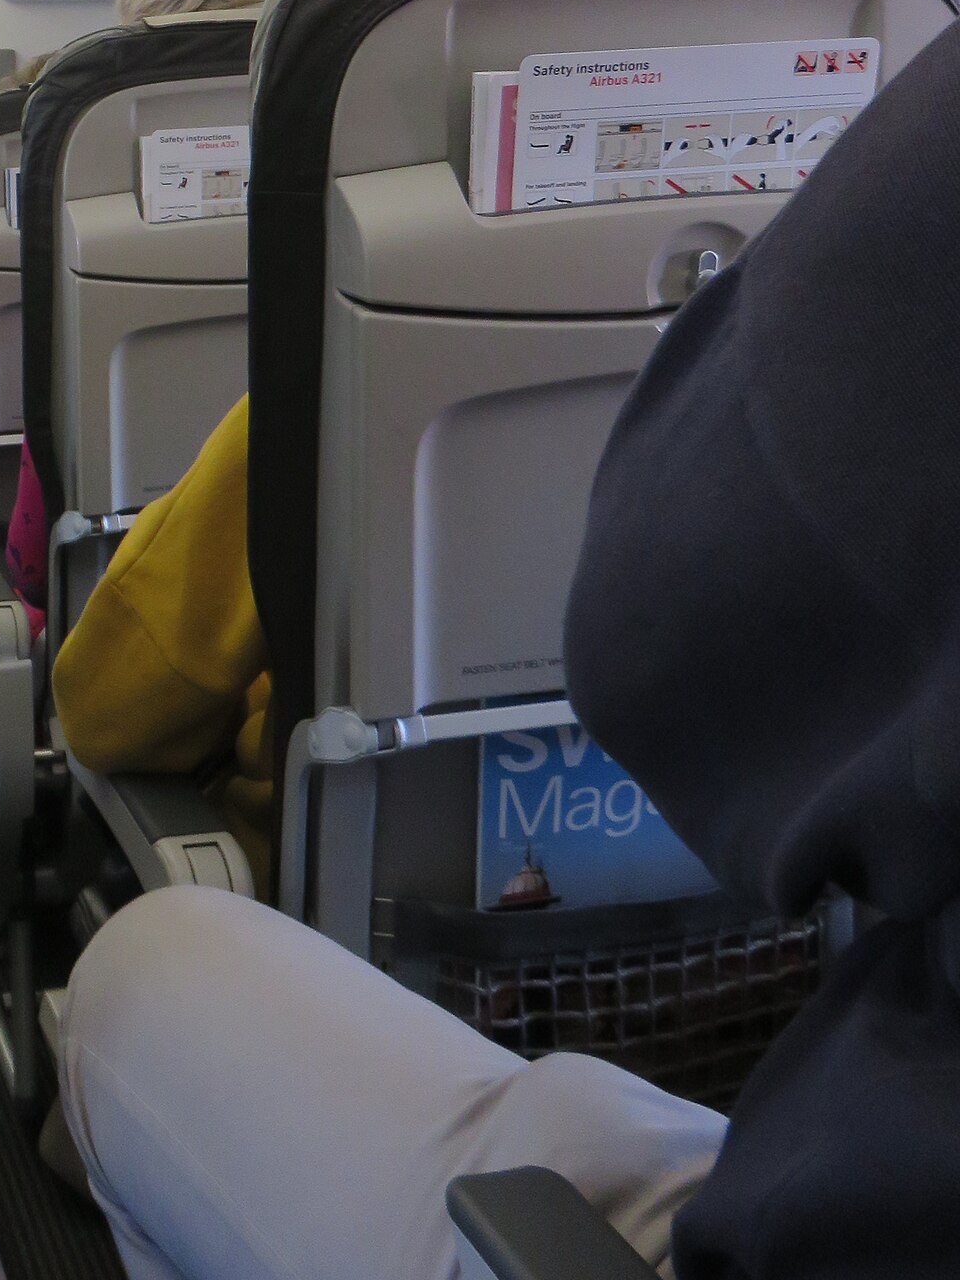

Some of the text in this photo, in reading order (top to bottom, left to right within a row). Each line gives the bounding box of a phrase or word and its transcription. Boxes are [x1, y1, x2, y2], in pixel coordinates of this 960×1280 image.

[533, 61, 649, 77] Safety instructions
[590, 72, 662, 87] Airbus A321
[541, 112, 562, 120] board
[195, 140, 240, 150] Airbus A321
[498, 775, 659, 838] Mag
